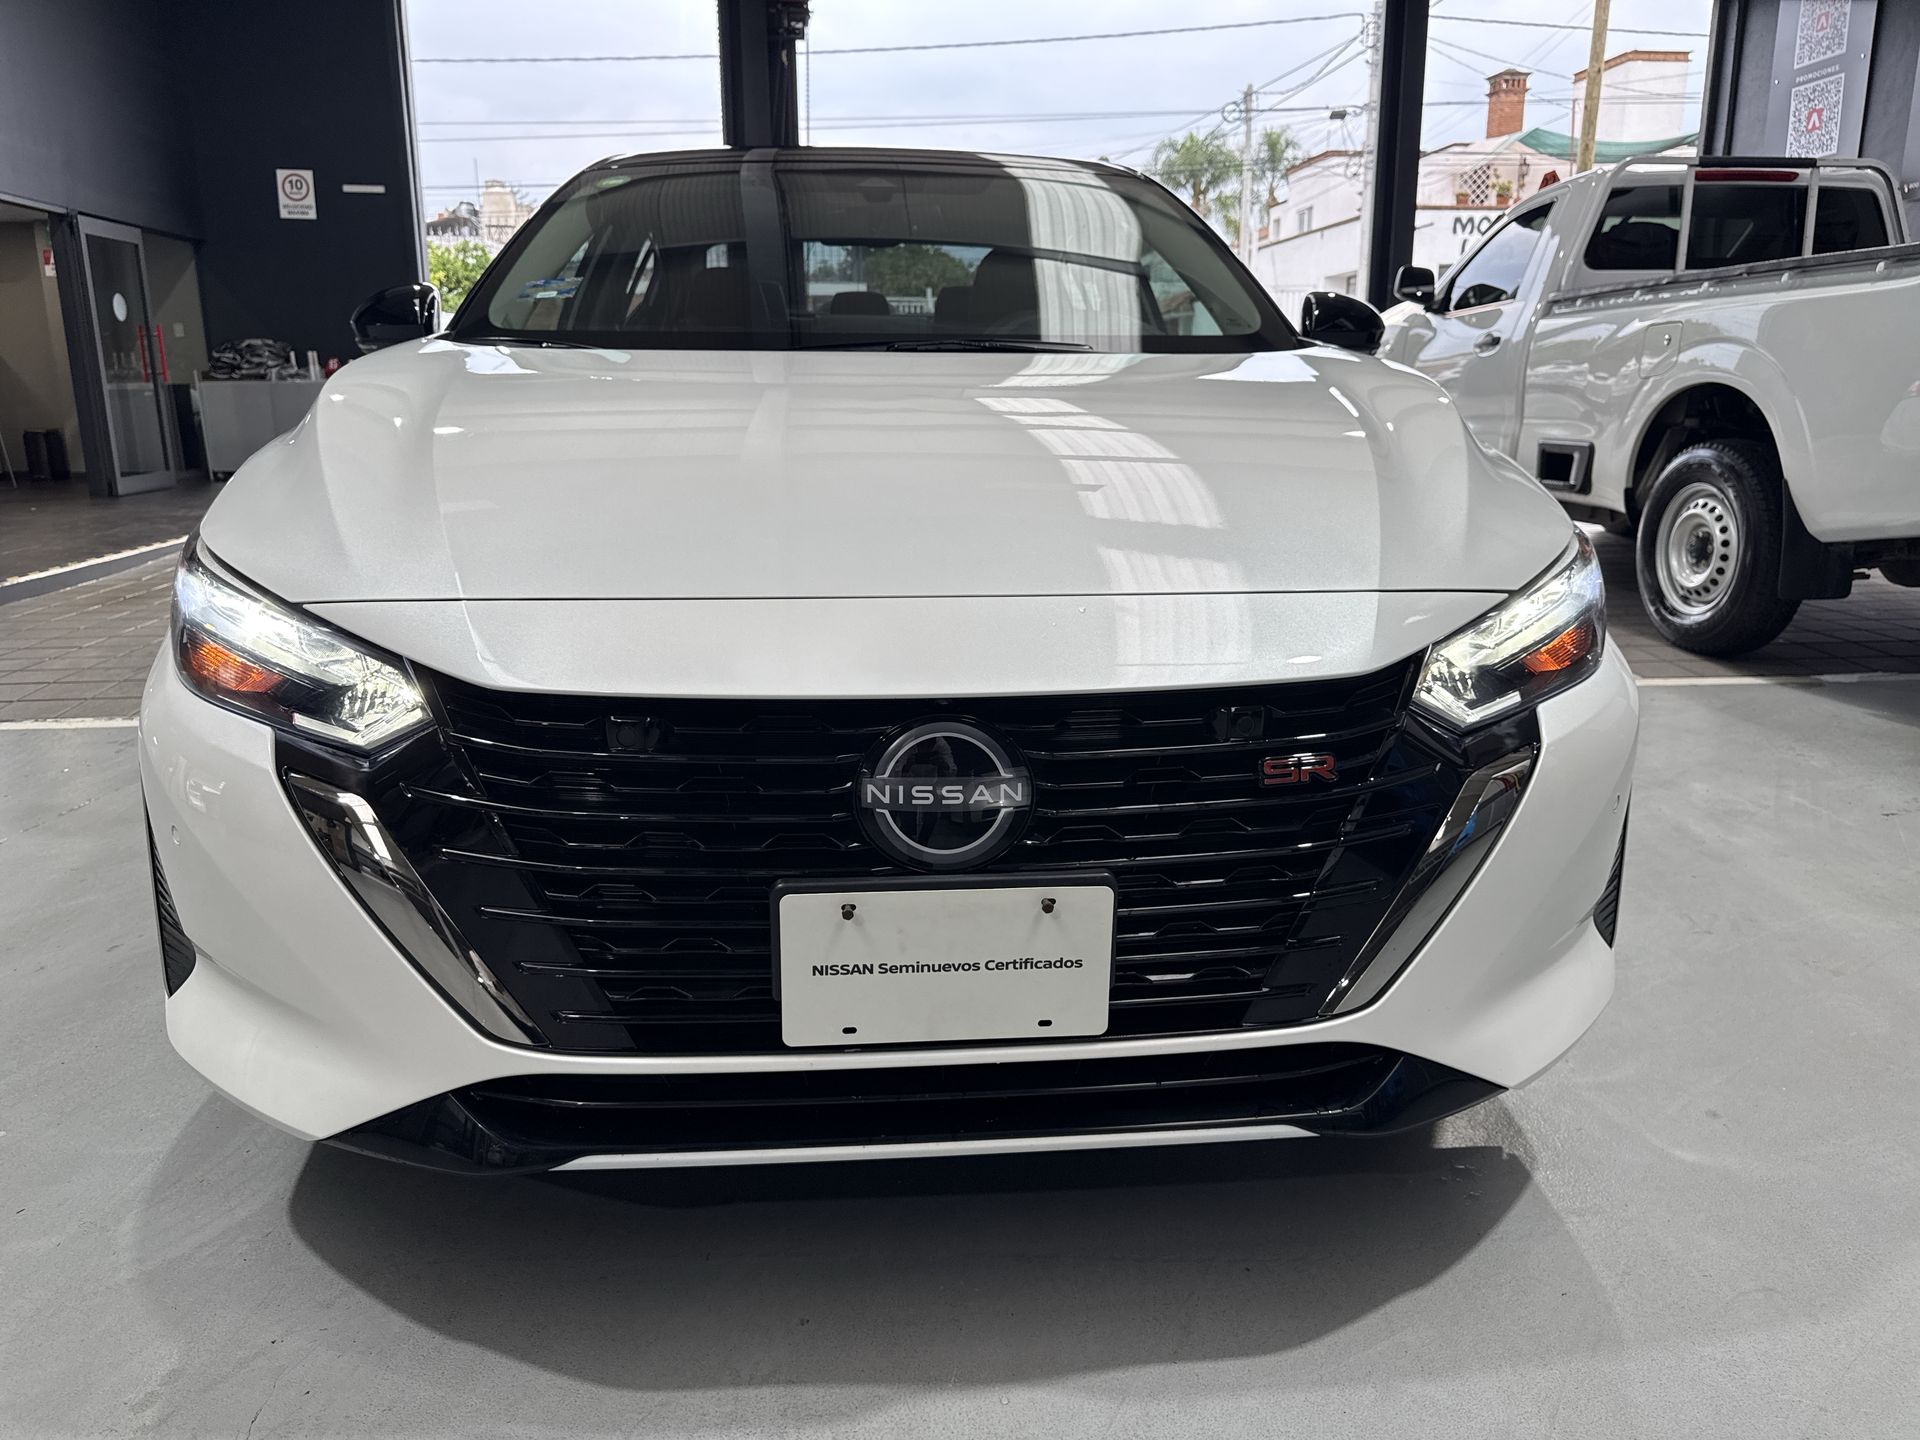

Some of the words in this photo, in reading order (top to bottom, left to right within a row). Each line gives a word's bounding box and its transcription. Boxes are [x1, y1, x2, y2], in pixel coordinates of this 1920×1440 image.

[1796, 64, 1840, 83] PROMOCIONES
[288, 179, 304, 191] 10
[1263, 754, 1336, 785] SR
[866, 782, 1023, 805] NISSAN
[811, 963, 874, 976] NISSAN
[878, 959, 981, 974] Seminuevos
[984, 957, 1083, 971] Certificados
